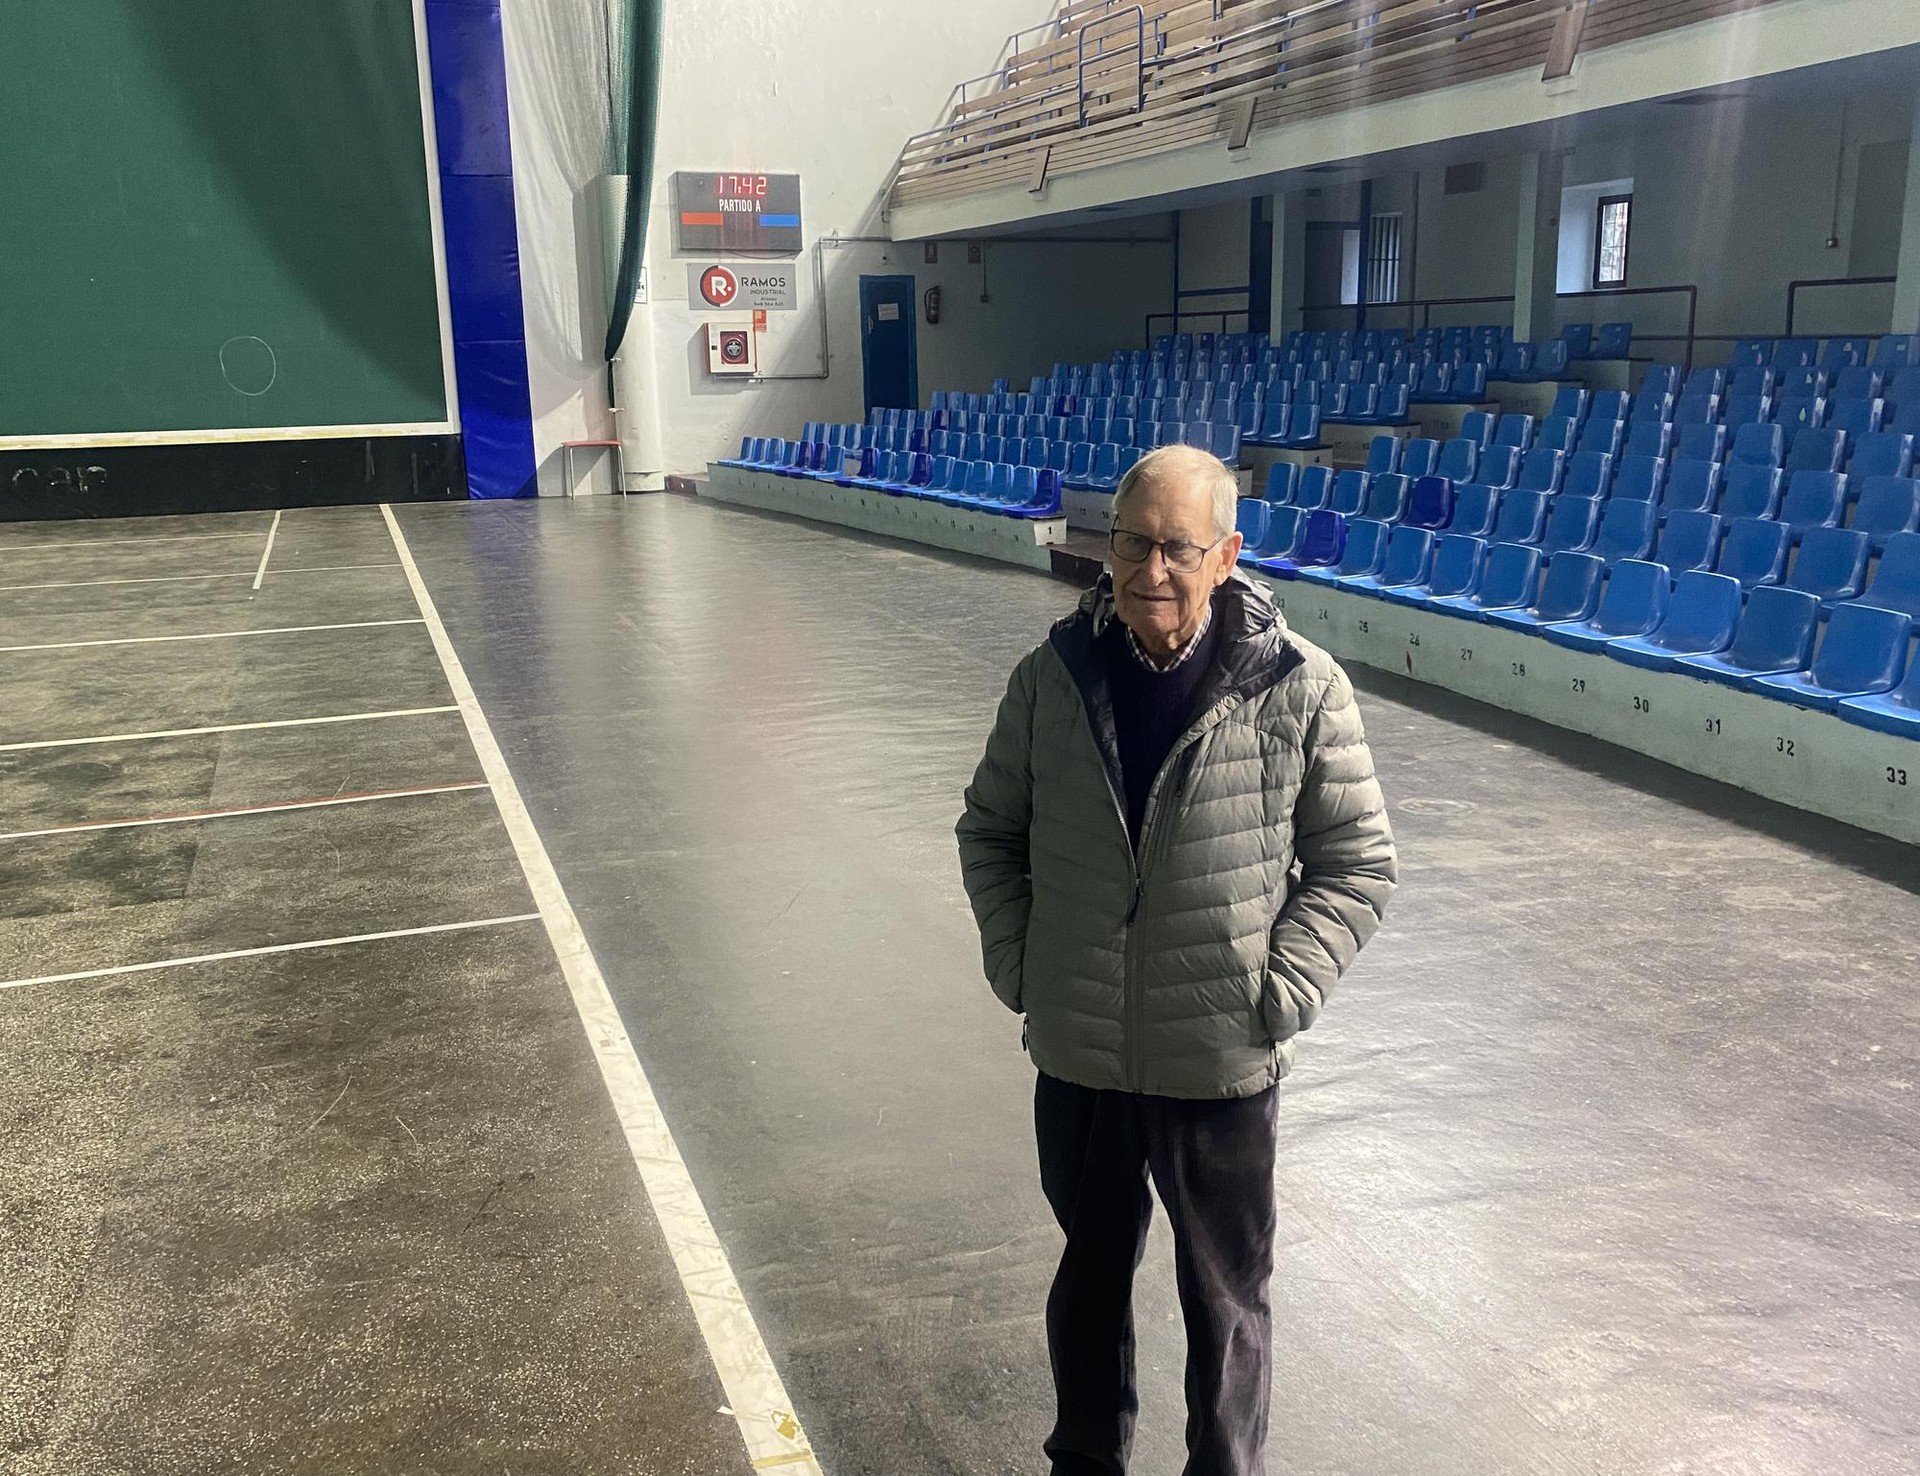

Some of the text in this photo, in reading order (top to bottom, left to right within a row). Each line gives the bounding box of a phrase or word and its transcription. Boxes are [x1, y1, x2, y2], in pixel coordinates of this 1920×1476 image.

[719, 199, 761, 212] PARTIDO A
[741, 277, 786, 287] RAMOS
[1048, 526, 1052, 534] 1
[1319, 609, 1328, 620] 24
[1359, 620, 1368, 633] 25
[1409, 633, 1420, 646] 26
[1461, 649, 1472, 661] 27
[1512, 663, 1525, 676] 28
[1572, 678, 1585, 693] 29
[1633, 696, 1649, 713] 30
[1705, 718, 1721, 734] 31
[1776, 736, 1794, 757] 32
[1886, 766, 1906, 785] 33
